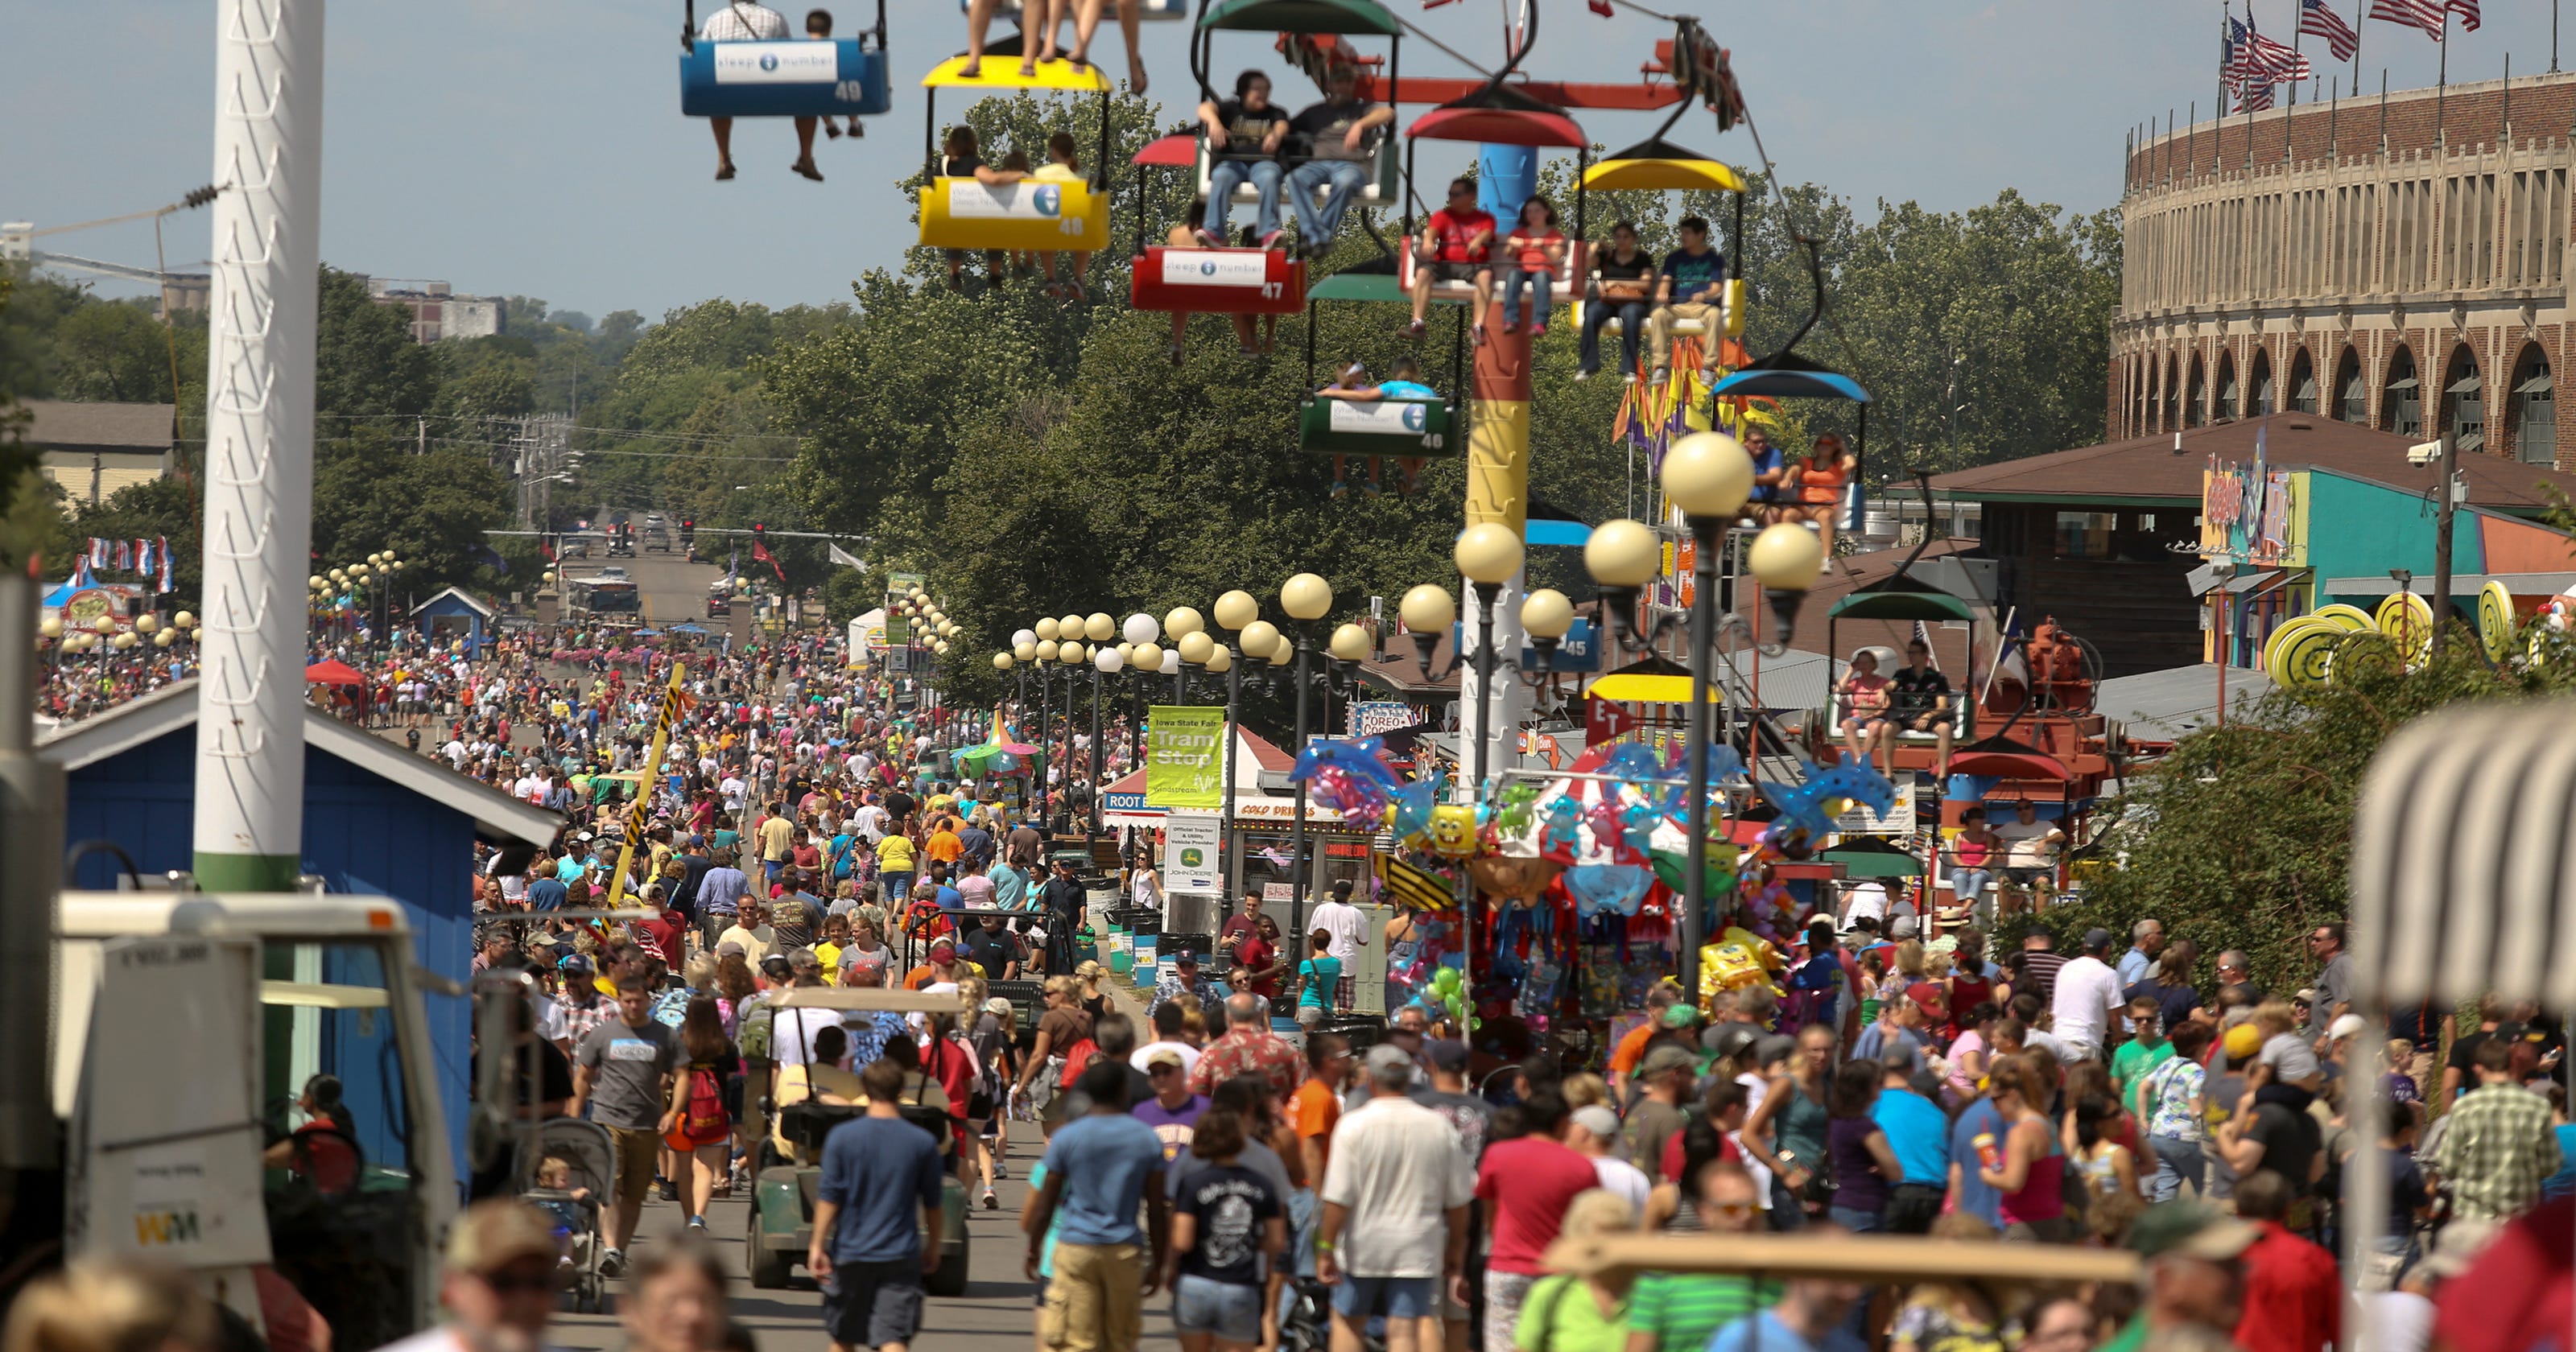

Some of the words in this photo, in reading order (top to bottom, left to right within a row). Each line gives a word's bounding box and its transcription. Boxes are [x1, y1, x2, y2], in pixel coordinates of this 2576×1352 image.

[780, 56, 833, 66] number
[835, 80, 863, 102] 49
[1059, 216, 1084, 237] 48
[1219, 262, 1263, 272] number
[1261, 282, 1283, 300] 47
[1420, 432, 1443, 450] 46
[1566, 641, 1587, 657] 45
[1156, 719, 1175, 727] Iowa
[1177, 719, 1199, 728] State
[1370, 716, 1400, 727] OREO
[1155, 730, 1215, 747] Tram
[1156, 749, 1212, 769] Stop
[1110, 795, 1141, 808] ROOT
[1241, 804, 1271, 815] COLD
[135, 1212, 200, 1243] WM
